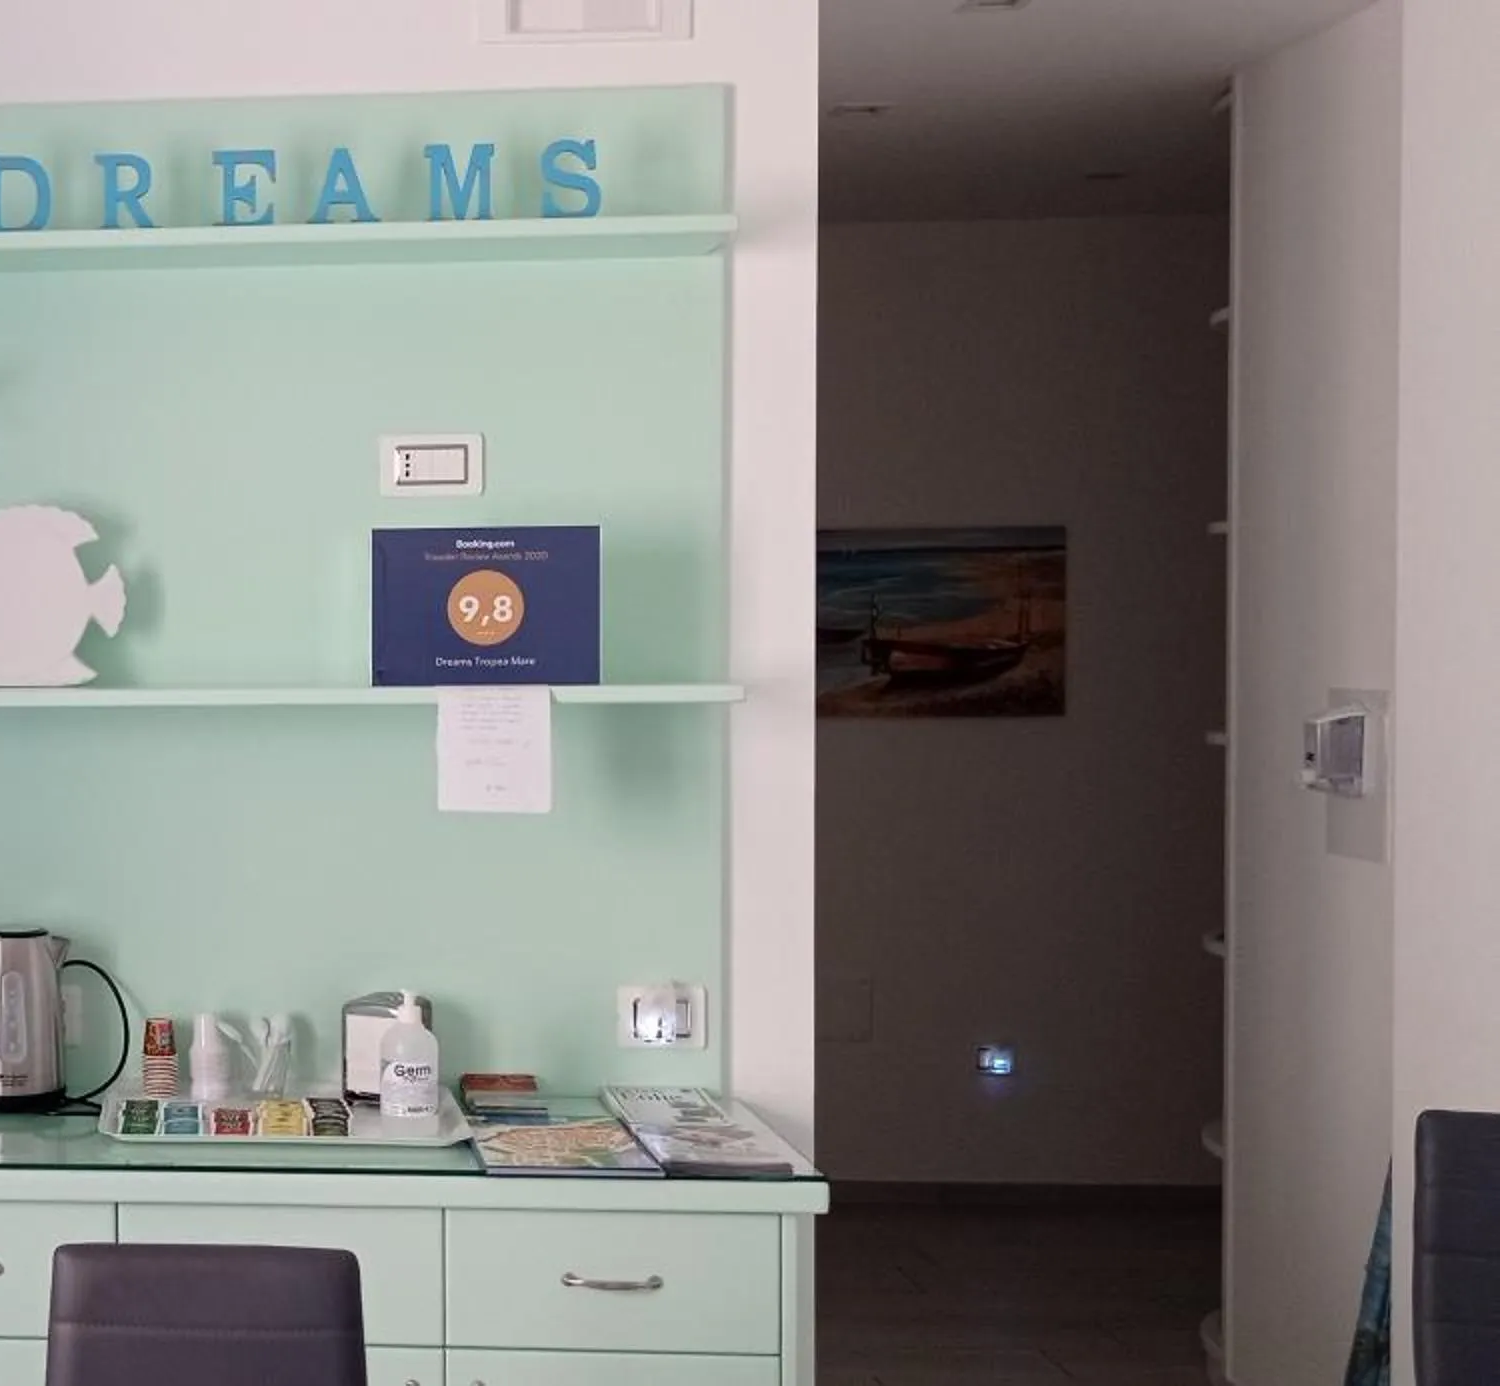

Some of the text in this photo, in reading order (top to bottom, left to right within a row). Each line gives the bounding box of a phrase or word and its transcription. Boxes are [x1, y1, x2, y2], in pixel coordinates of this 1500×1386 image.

[455, 540, 515, 549] Booking.com
[459, 595, 513, 627] 9,8
[435, 655, 537, 668] Dreams Tropea Mare
